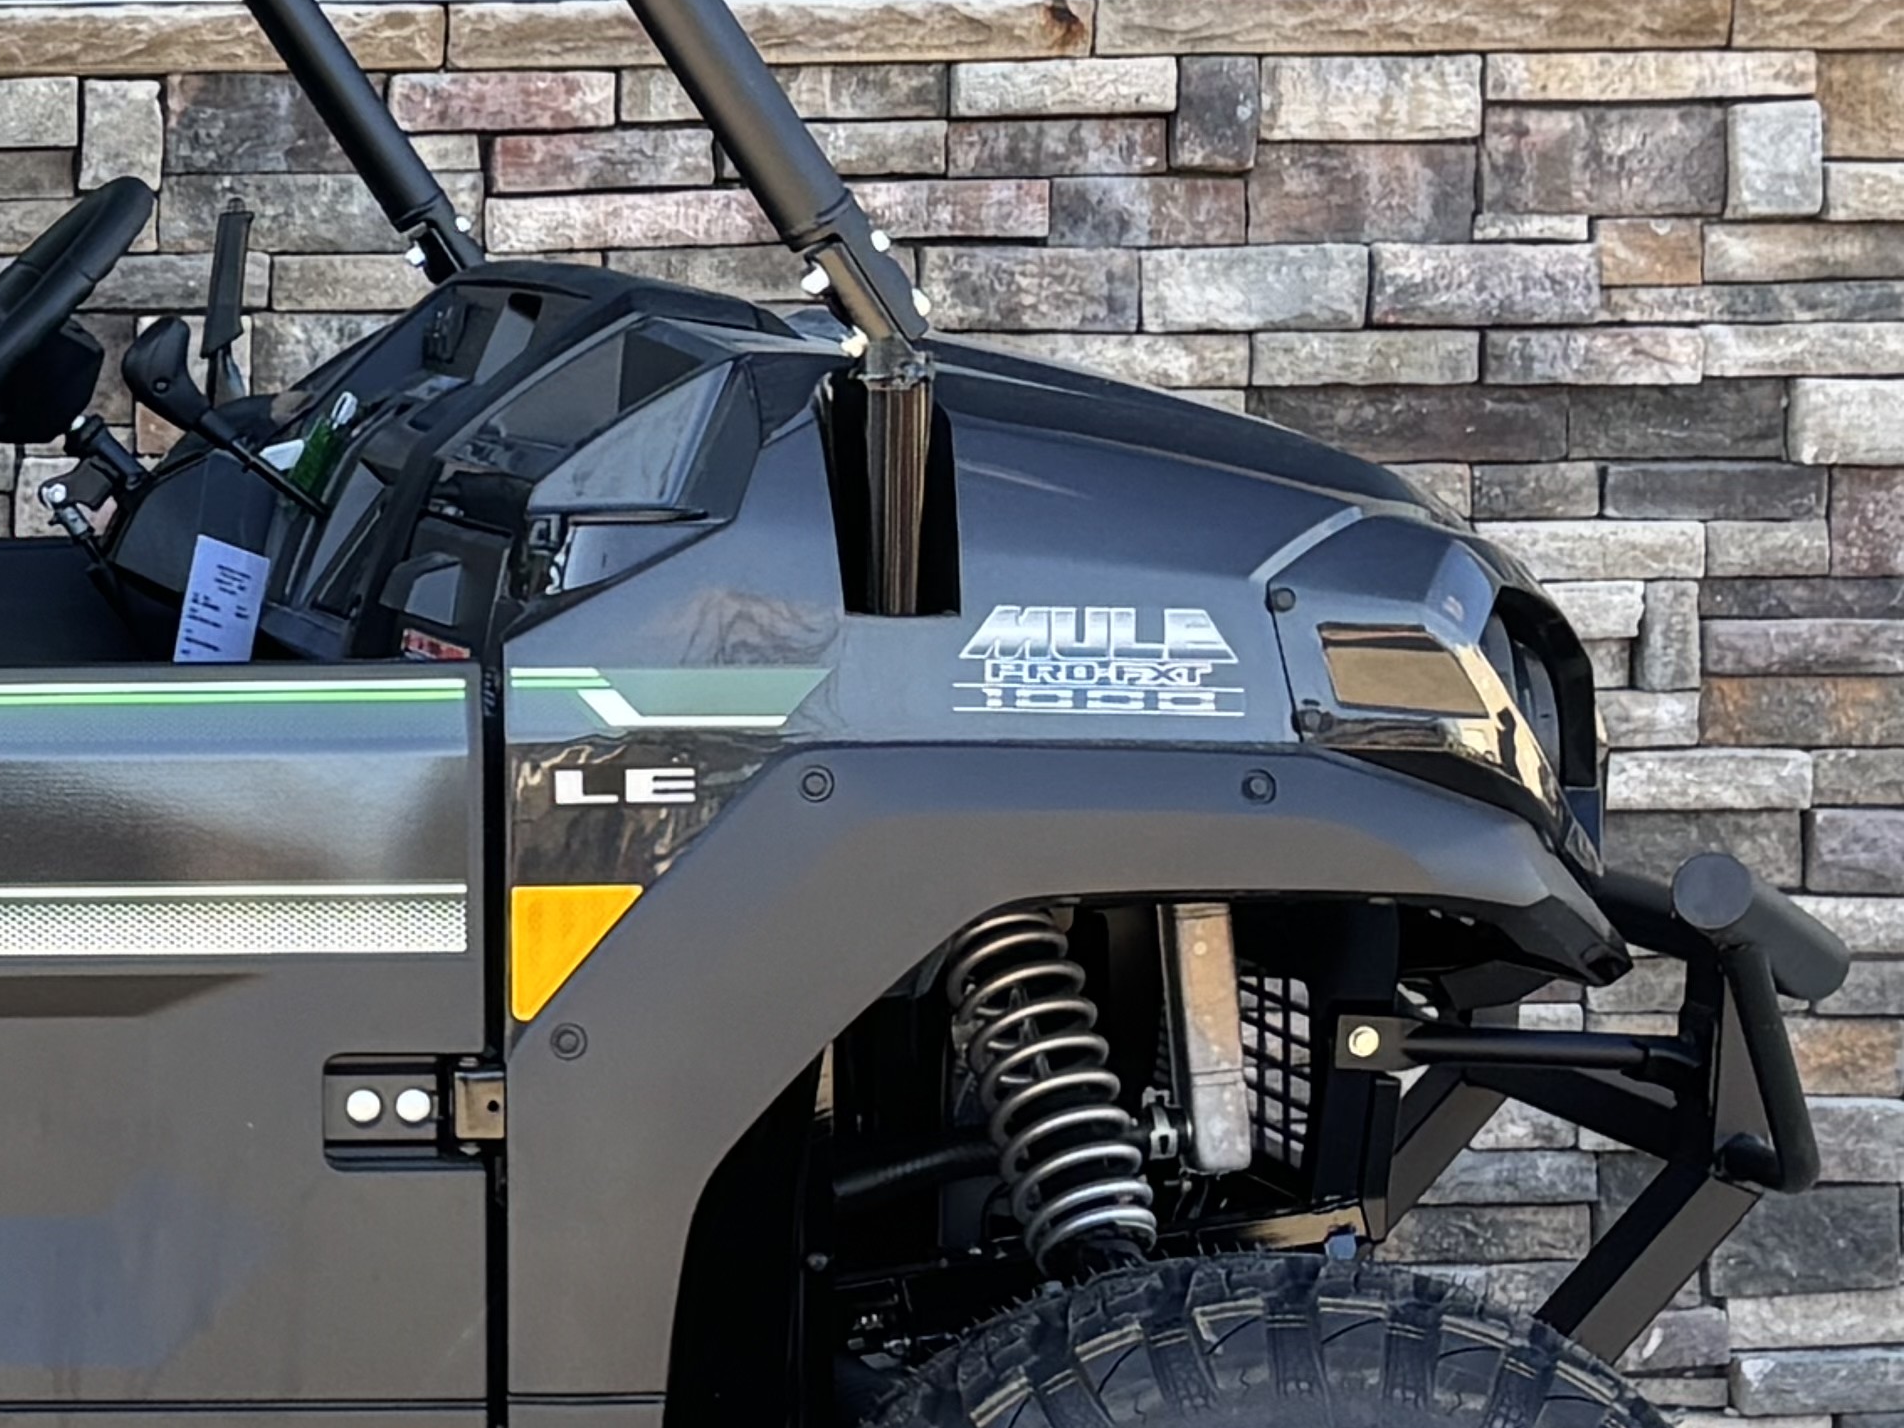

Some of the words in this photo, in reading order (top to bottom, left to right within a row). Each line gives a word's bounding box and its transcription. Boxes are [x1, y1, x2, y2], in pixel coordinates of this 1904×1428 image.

[958, 604, 1240, 664] MULE
[982, 687, 1216, 711] 1000
[554, 767, 697, 806] LE
